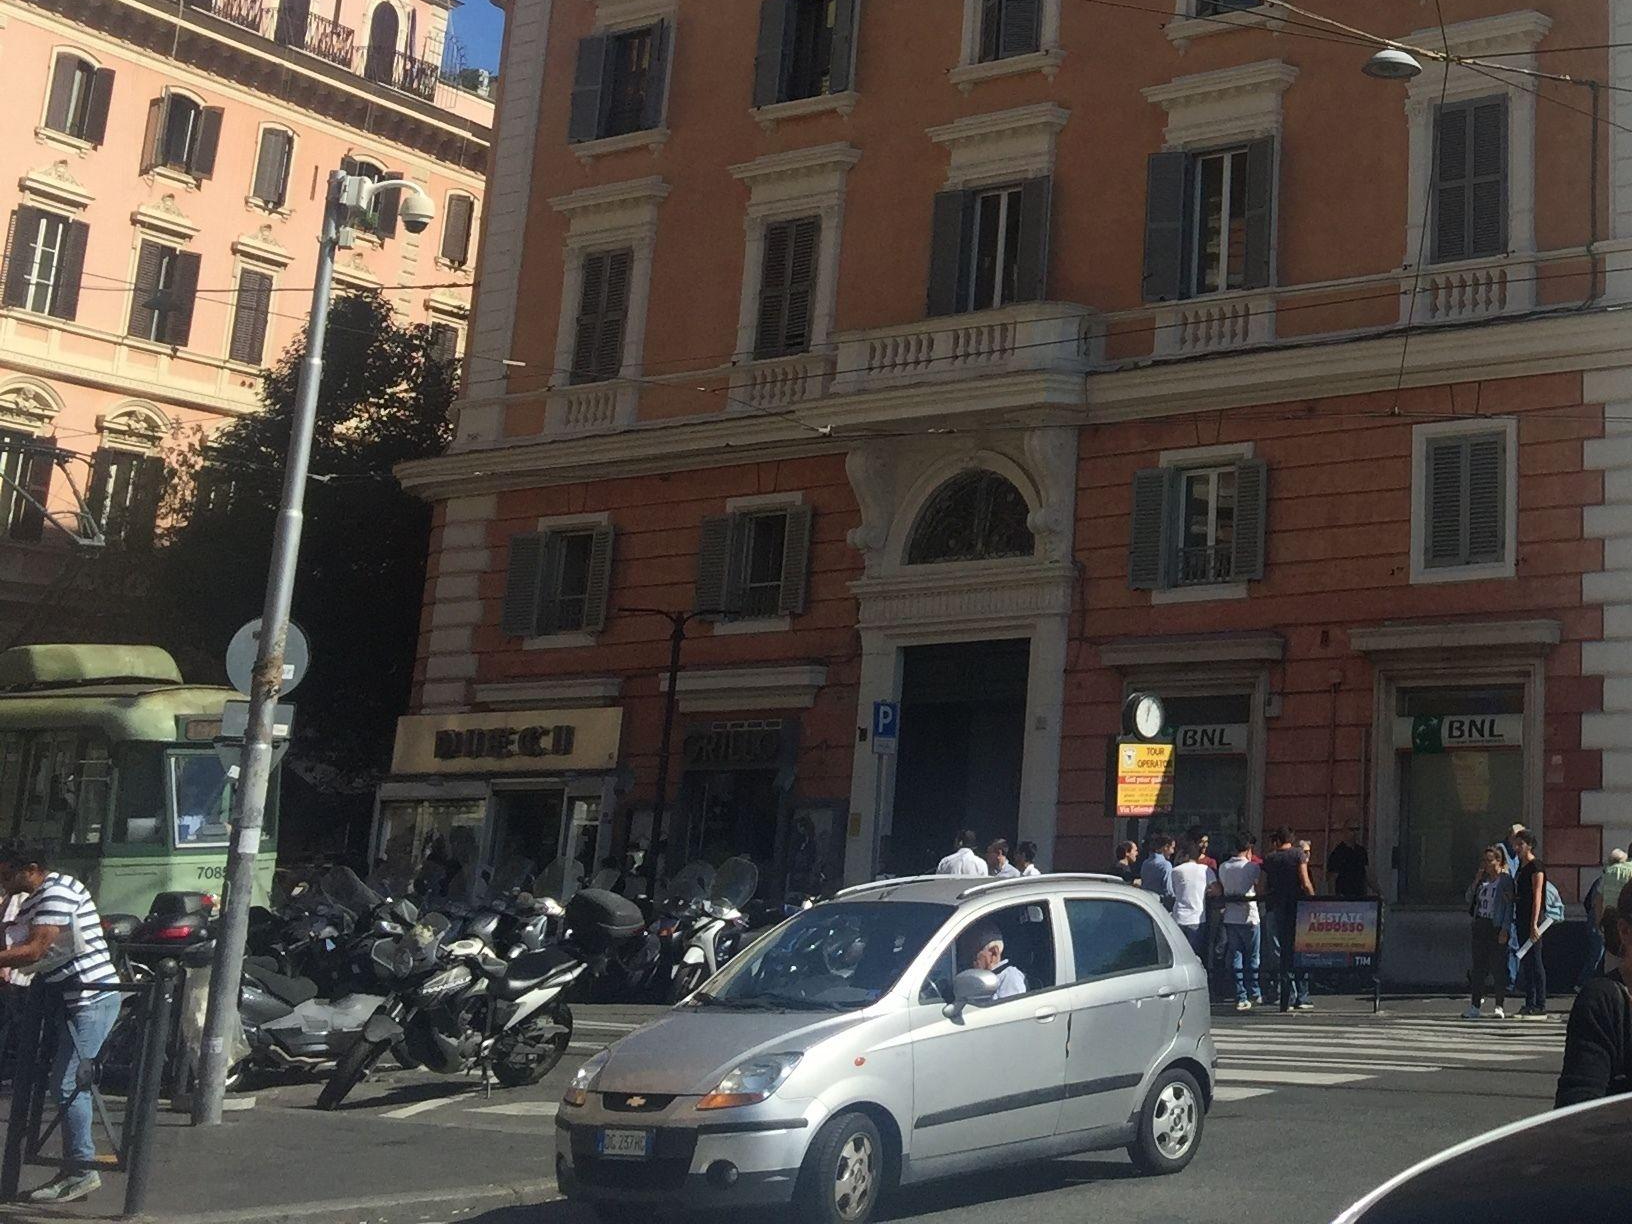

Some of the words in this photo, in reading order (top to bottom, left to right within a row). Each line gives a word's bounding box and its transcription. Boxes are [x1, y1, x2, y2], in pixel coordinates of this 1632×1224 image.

[879, 705, 893, 733] P
[1448, 719, 1504, 739] BNL
[1182, 727, 1233, 747] BNL
[1146, 747, 1165, 756] TOUR
[1310, 912, 1363, 923] L'ESTATE
[1308, 922, 1365, 932] ADDOSSO
[1354, 956, 1371, 966] TIM
